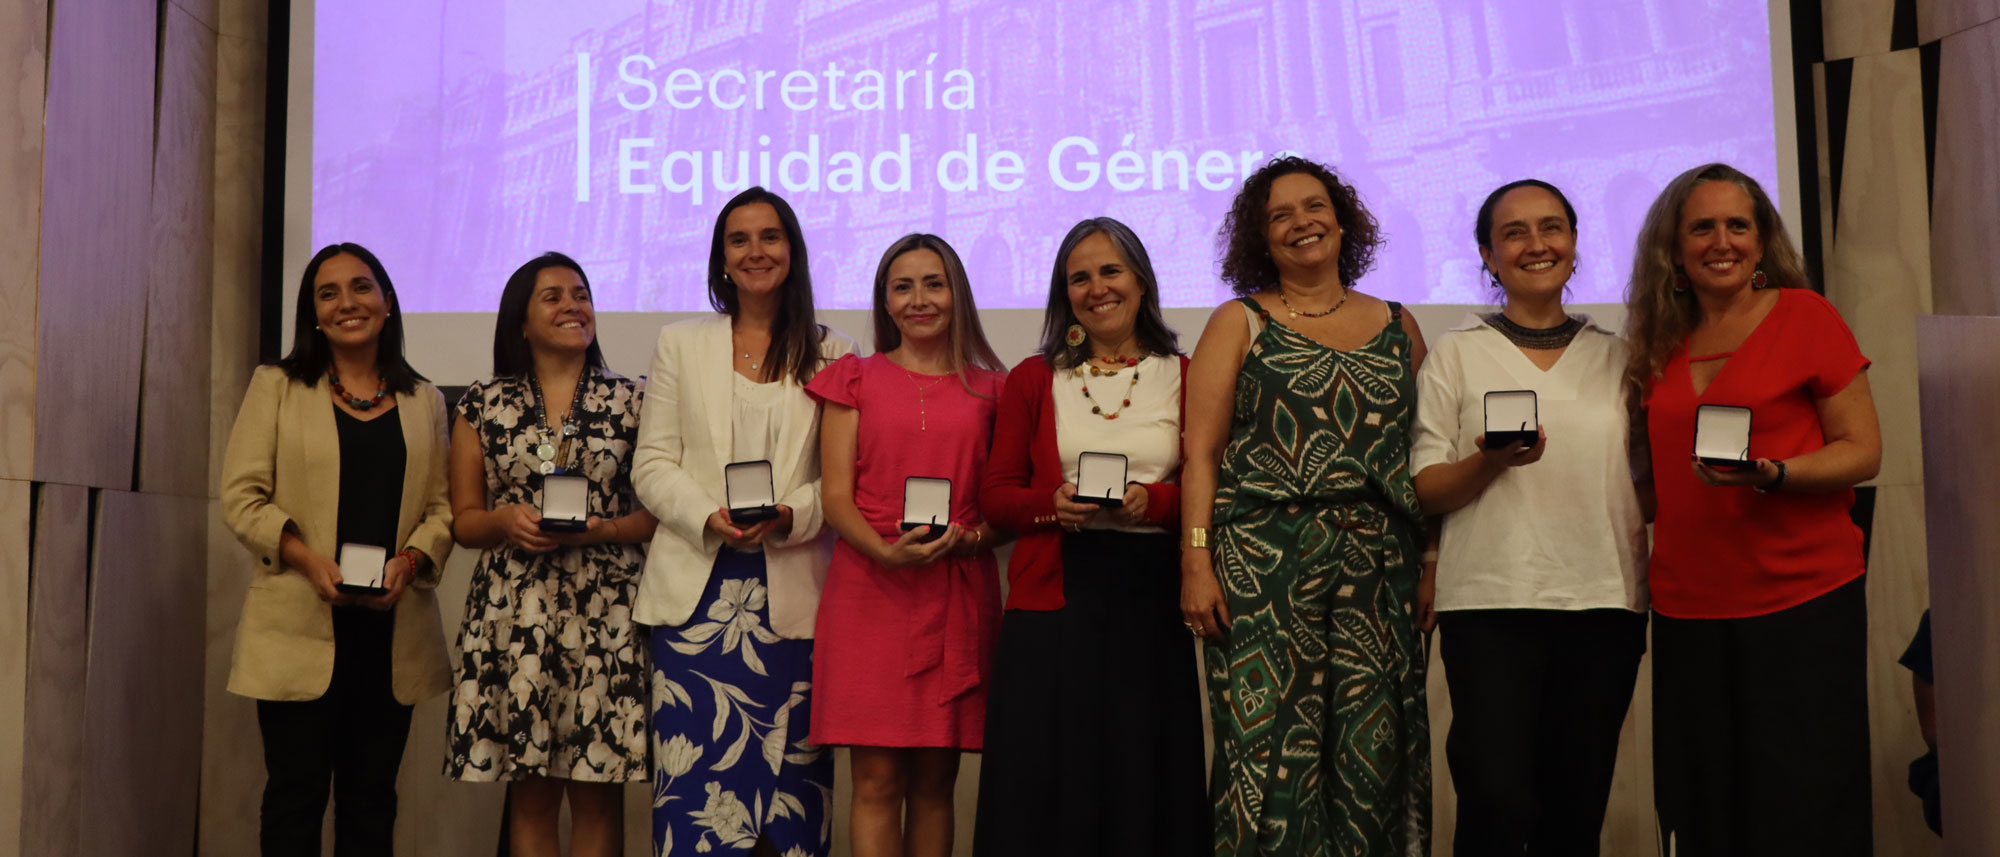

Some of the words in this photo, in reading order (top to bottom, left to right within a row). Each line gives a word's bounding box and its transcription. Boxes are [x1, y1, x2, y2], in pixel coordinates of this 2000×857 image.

[616, 53, 976, 111] Secretaría
[618, 135, 912, 204] Equidad
[935, 134, 1026, 192] de
[1047, 133, 1303, 192] Géner
